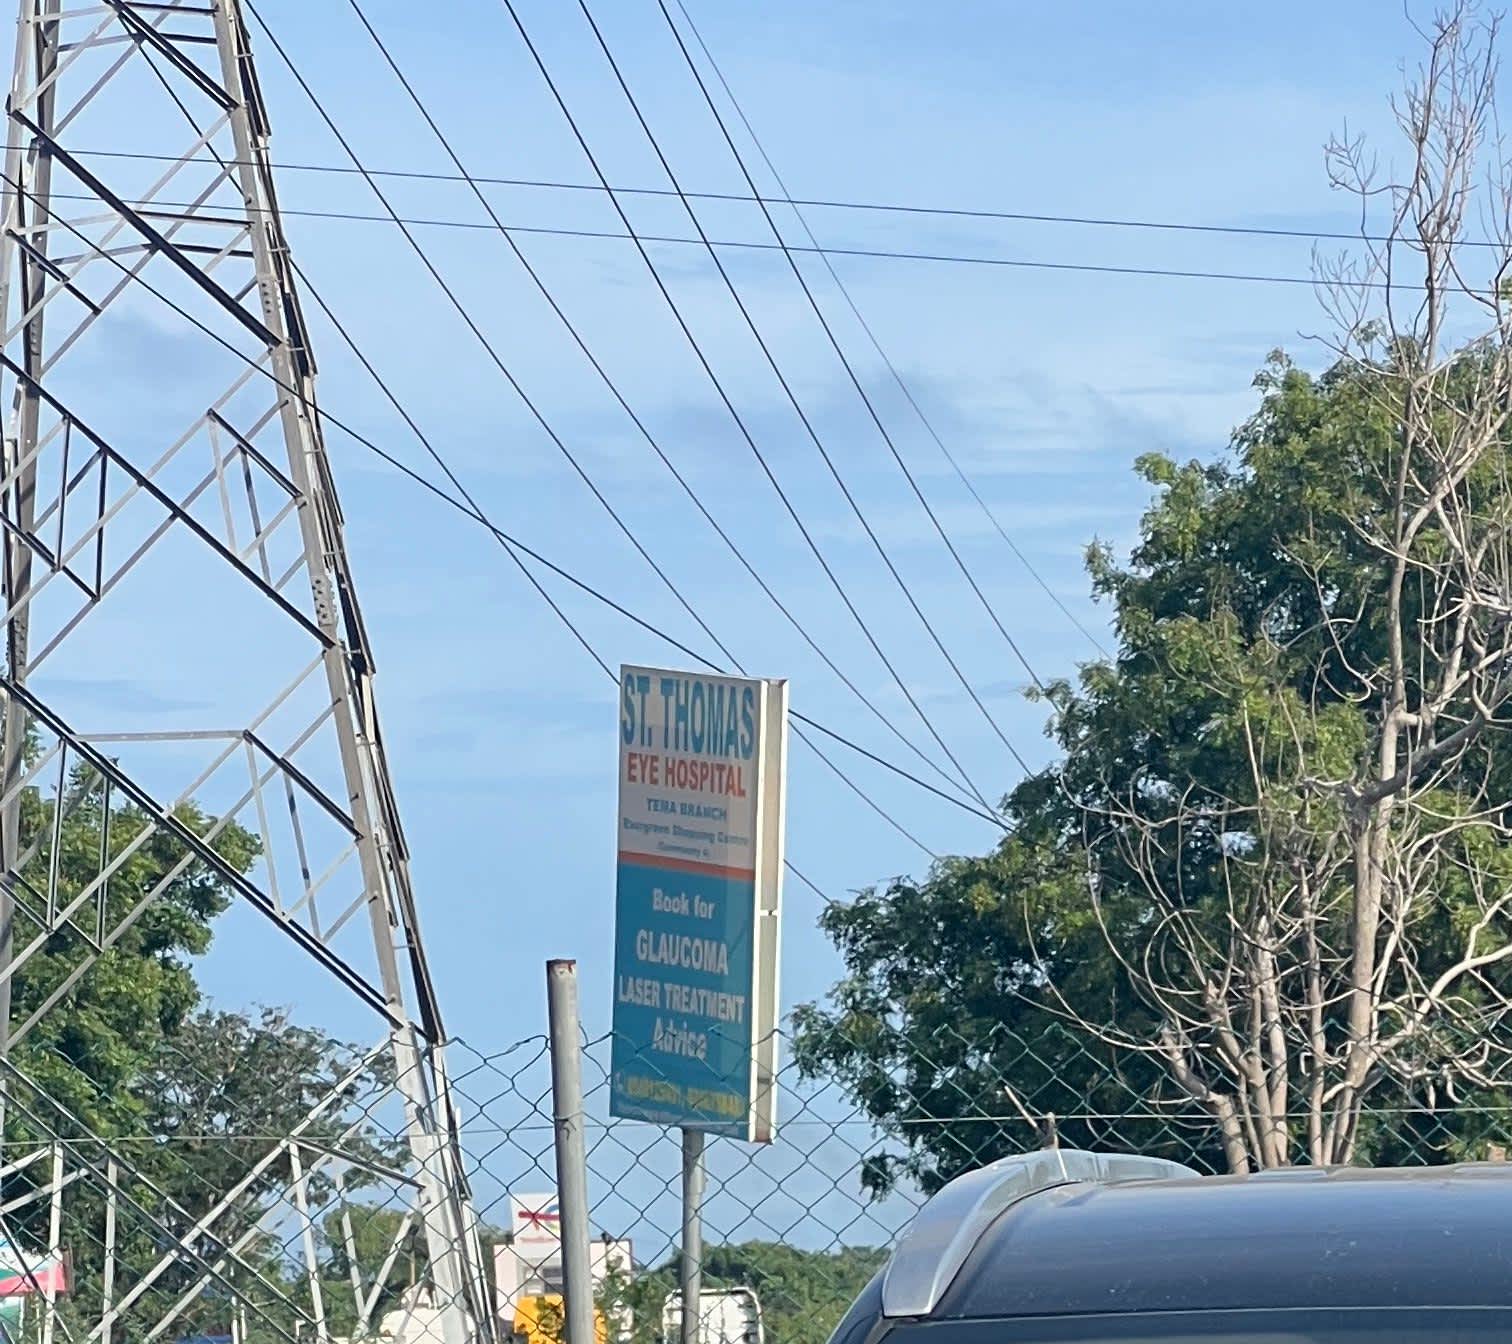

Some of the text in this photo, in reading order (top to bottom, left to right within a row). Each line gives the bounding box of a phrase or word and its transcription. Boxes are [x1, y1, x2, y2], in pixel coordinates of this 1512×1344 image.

[661, 678, 754, 759] THOMAS
[627, 752, 746, 797] EYE HOSPITAL
[680, 803, 727, 821] BRANCH
[652, 887, 716, 919] Book for
[636, 928, 729, 976] GLAUCOMA
[618, 976, 745, 1024] LASER TREATMENT
[652, 1016, 707, 1059] Advice
